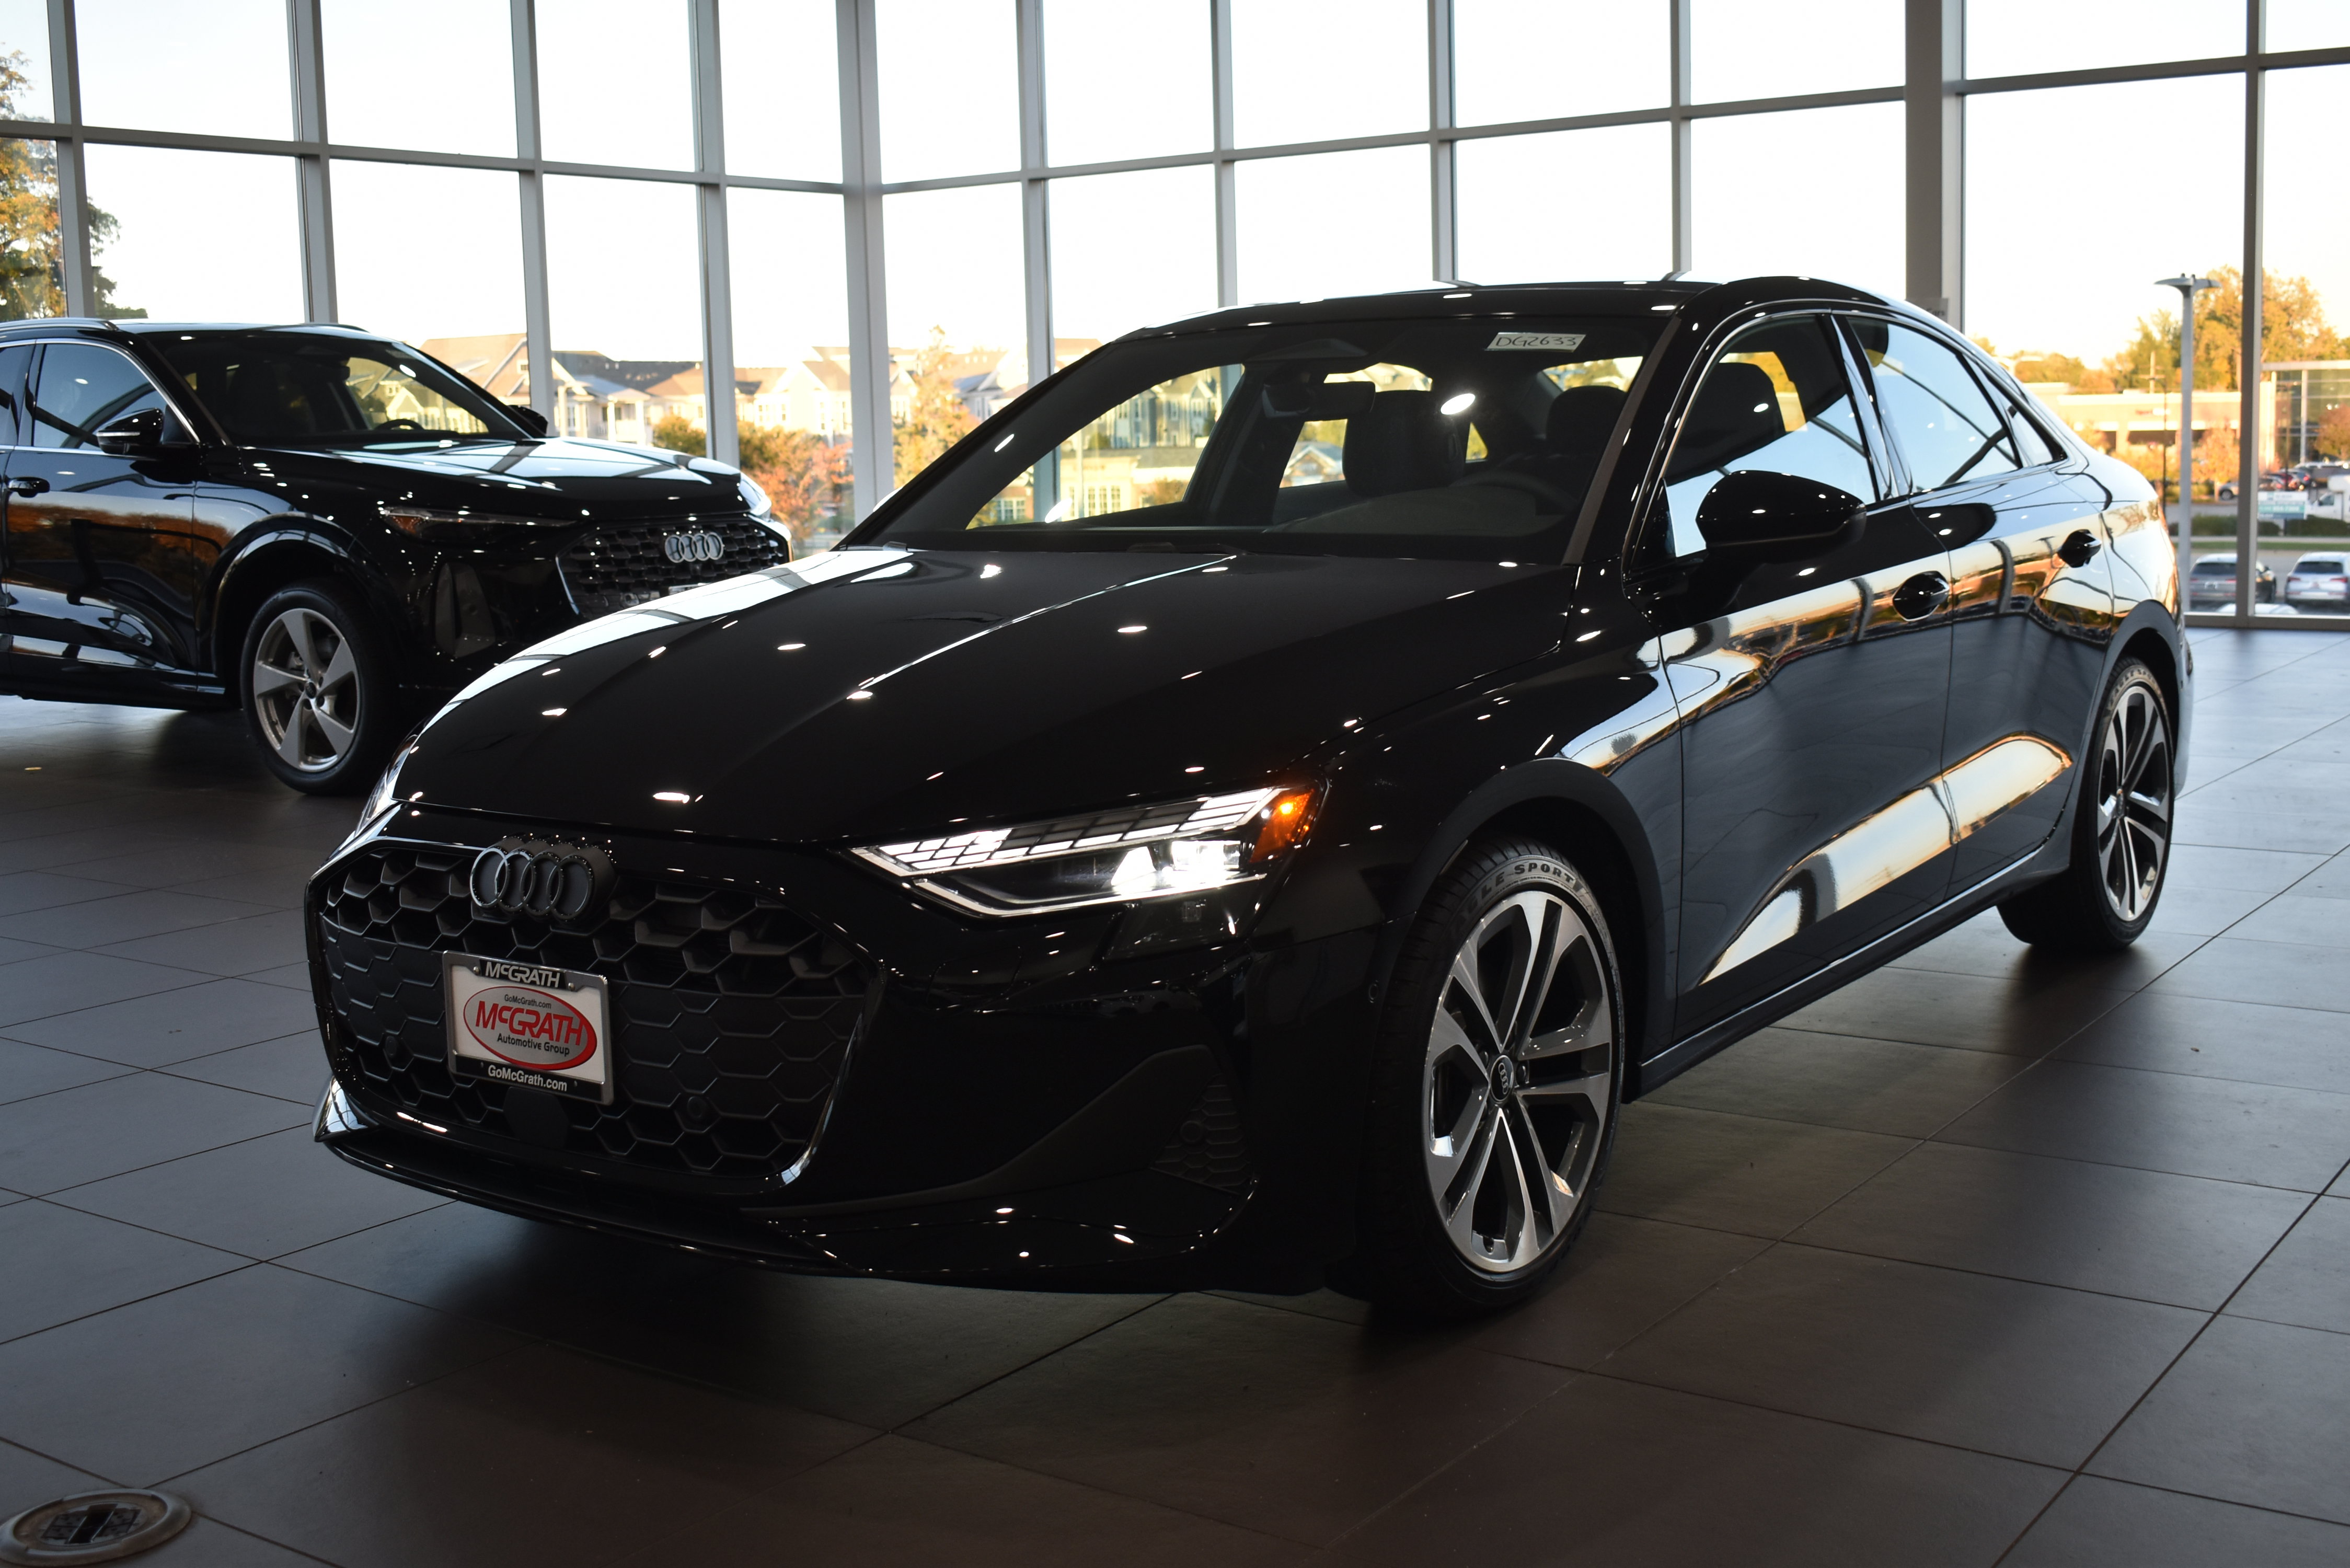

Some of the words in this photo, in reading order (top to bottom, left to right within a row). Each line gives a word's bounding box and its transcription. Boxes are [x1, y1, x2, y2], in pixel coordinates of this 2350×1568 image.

[1495, 337, 1577, 347] DG2633
[1514, 862, 1574, 883] SPORT
[504, 994, 551, 1009] GoMcGrath.com
[497, 1033, 542, 1050] Automotive
[544, 1042, 570, 1056] Group
[488, 1065, 567, 1091] GoMcGrath.com
